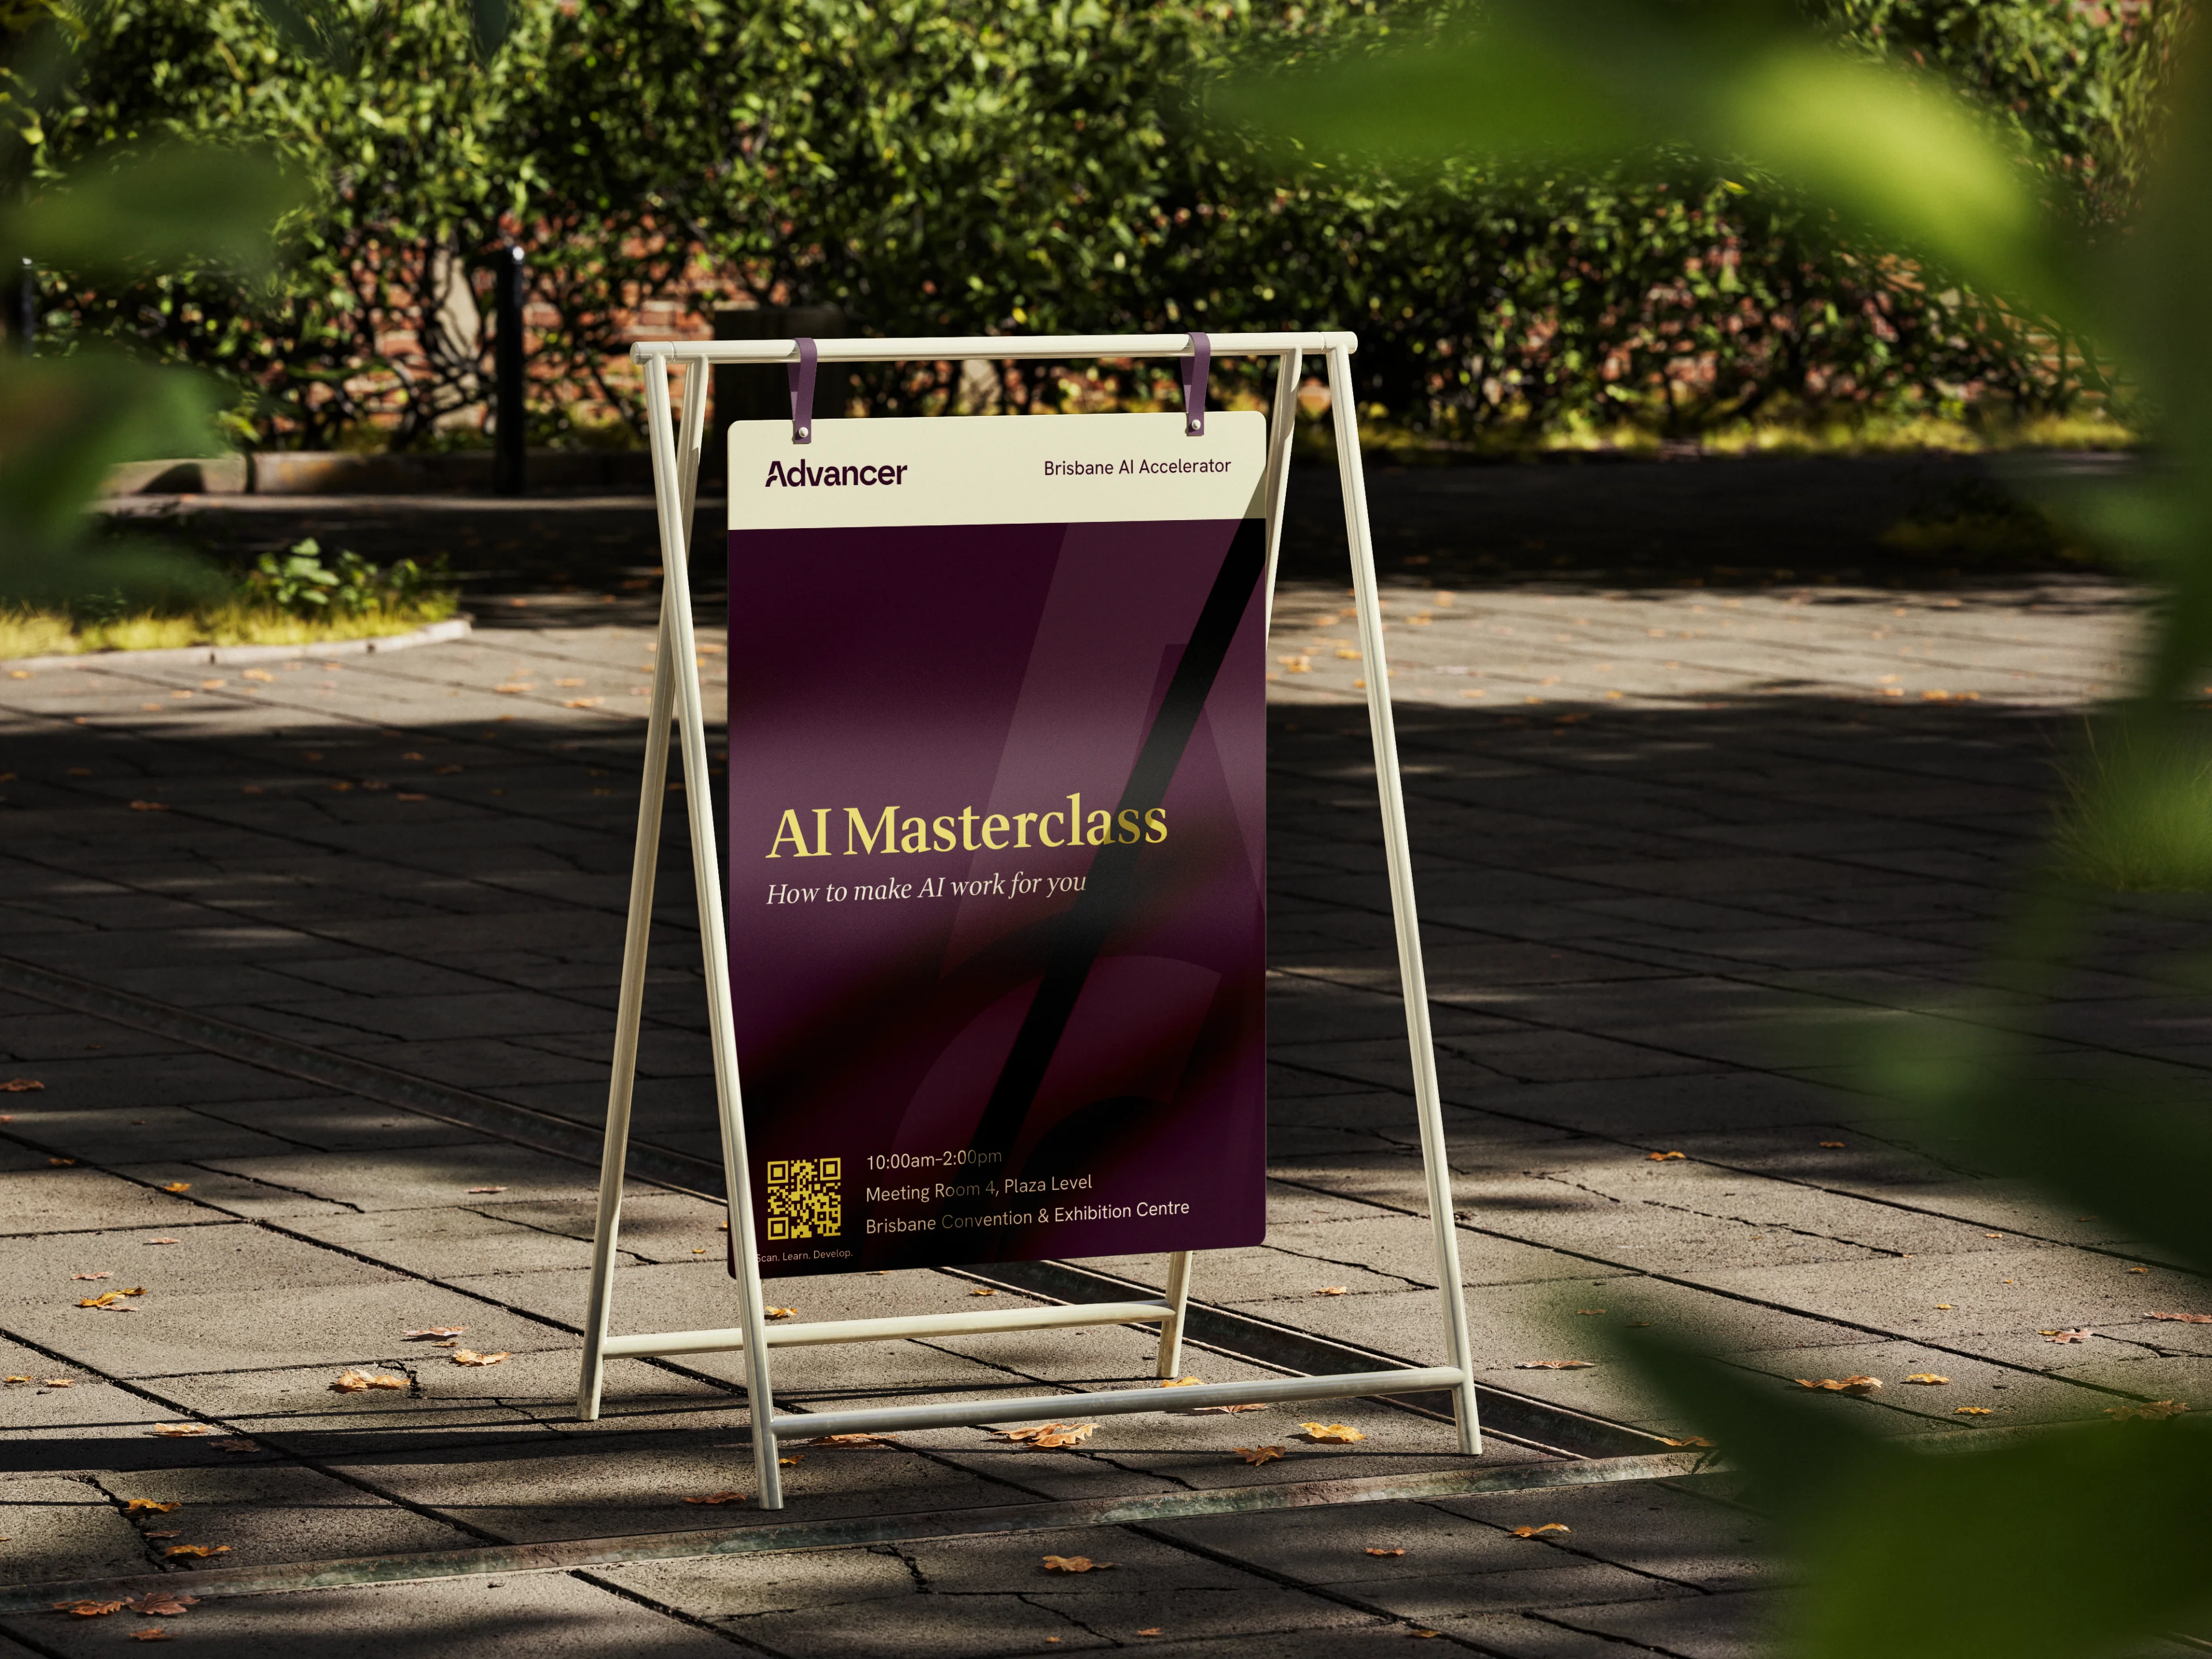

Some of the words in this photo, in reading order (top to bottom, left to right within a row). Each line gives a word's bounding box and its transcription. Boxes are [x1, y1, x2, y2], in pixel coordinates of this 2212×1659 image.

[764, 459, 908, 487] Advancer
[1044, 460, 1114, 476] Brisbane
[1118, 459, 1134, 475] AI
[1138, 458, 1232, 474] Accelerator
[765, 808, 832, 858] AI
[843, 792, 1168, 855] Masterclass
[766, 884, 821, 905] How
[826, 883, 847, 903] to
[854, 877, 912, 901] make
[916, 877, 946, 898] AI
[950, 872, 1006, 896] work
[1008, 871, 1043, 899] for
[1046, 876, 1086, 898] you
[866, 1185, 930, 1203] Meeting
[935, 1183, 980, 1198] Room
[985, 1180, 999, 1198] 4,
[1005, 1178, 1046, 1194] Plaza
[1052, 1174, 1093, 1191] Level
[866, 1217, 936, 1234] Brisbane
[942, 1210, 1032, 1229] Convention
[1037, 1208, 1049, 1223] &
[1055, 1204, 1131, 1222] Exhibition
[1137, 1200, 1190, 1217] Centre
[757, 1254, 780, 1263] Scan.
[783, 1252, 810, 1261] Learn.
[813, 1249, 853, 1259] Develop.
